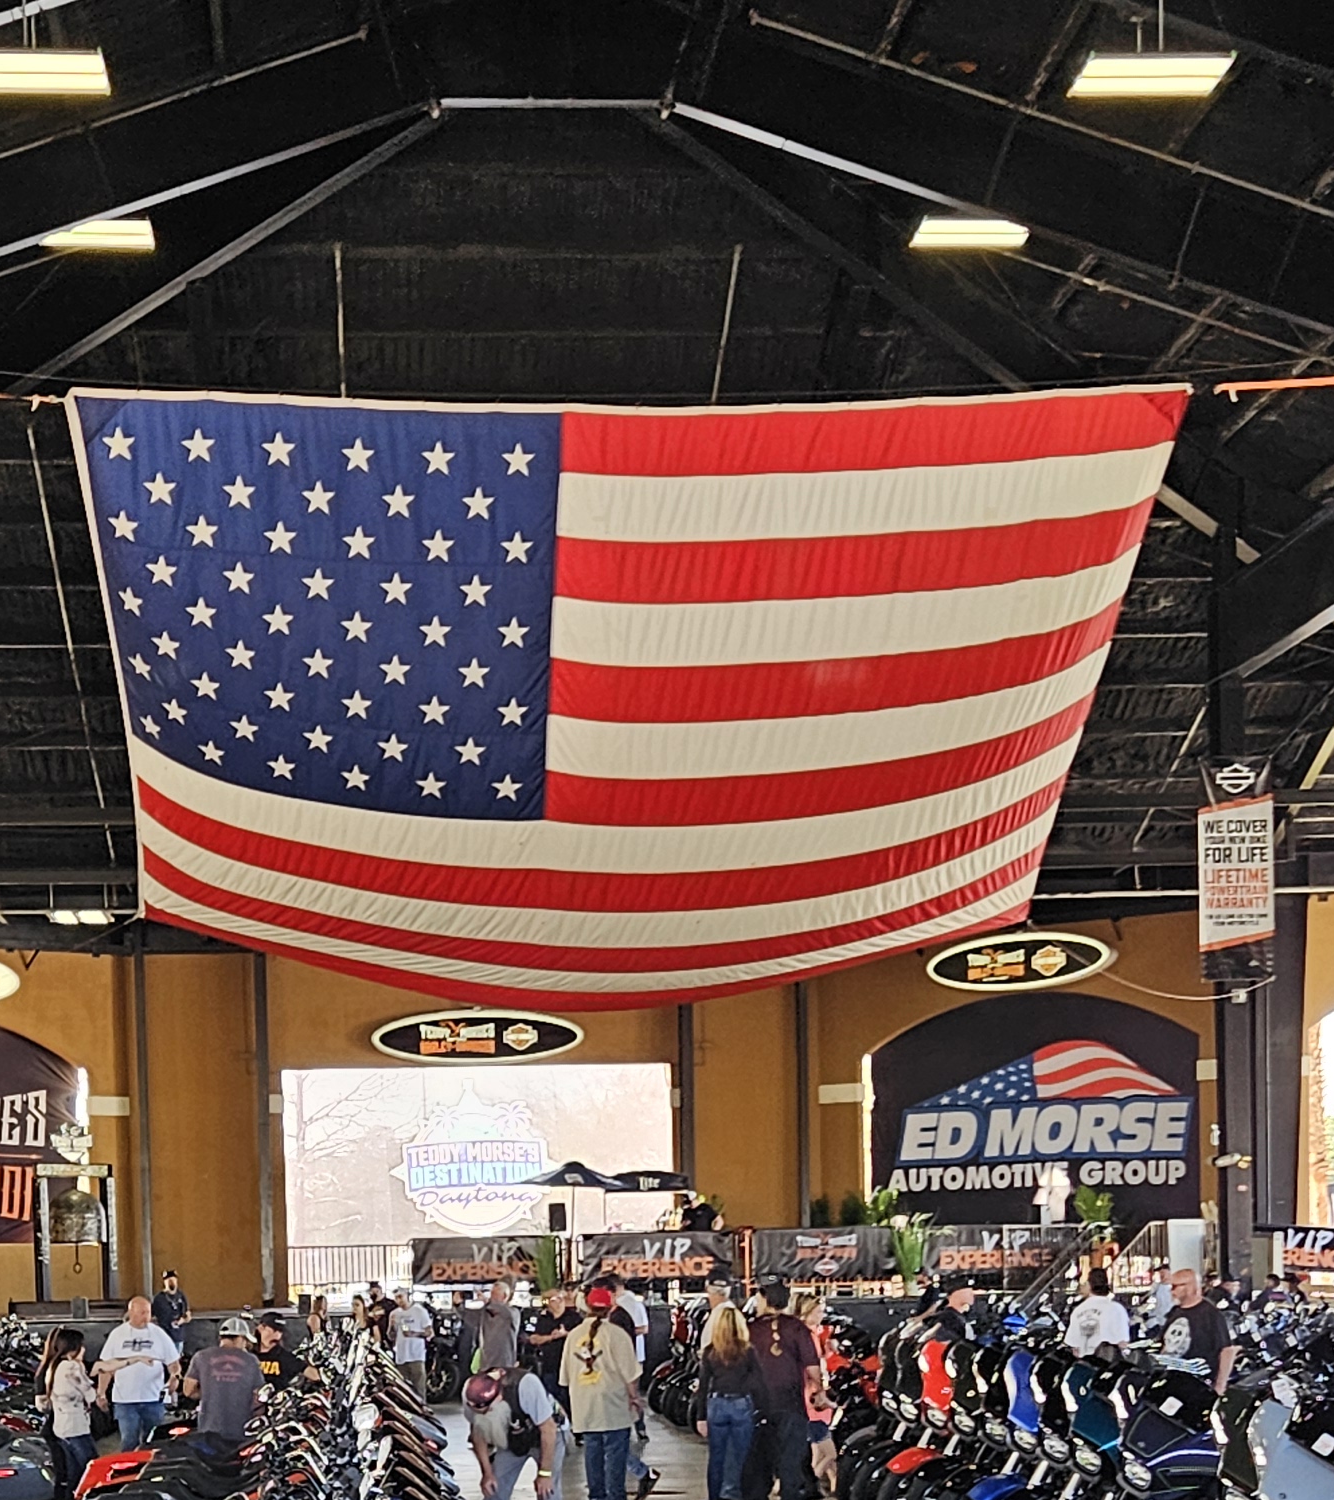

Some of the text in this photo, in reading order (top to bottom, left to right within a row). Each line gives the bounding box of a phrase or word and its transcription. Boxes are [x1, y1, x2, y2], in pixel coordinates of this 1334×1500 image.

[1203, 820, 1268, 834] WE COVER
[1204, 847, 1268, 864] FOR LIFE
[1205, 868, 1269, 884] LIFETIME
[1205, 886, 1269, 896] POWERTRAIN
[1205, 897, 1269, 909] WARRANTY
[900, 1101, 1191, 1161] ED MORSE
[408, 1141, 540, 1168] TEDDY MORSE'S
[410, 1162, 541, 1190] DESTINATION
[888, 1159, 1187, 1193] AUTOMOTIVE GROUP
[417, 1187, 538, 1209] Daytona
[1283, 1228, 1334, 1250] VIP
[472, 1240, 520, 1266] VIP
[642, 1238, 692, 1264] VIP
[601, 1257, 715, 1278] EXPERIENCE
